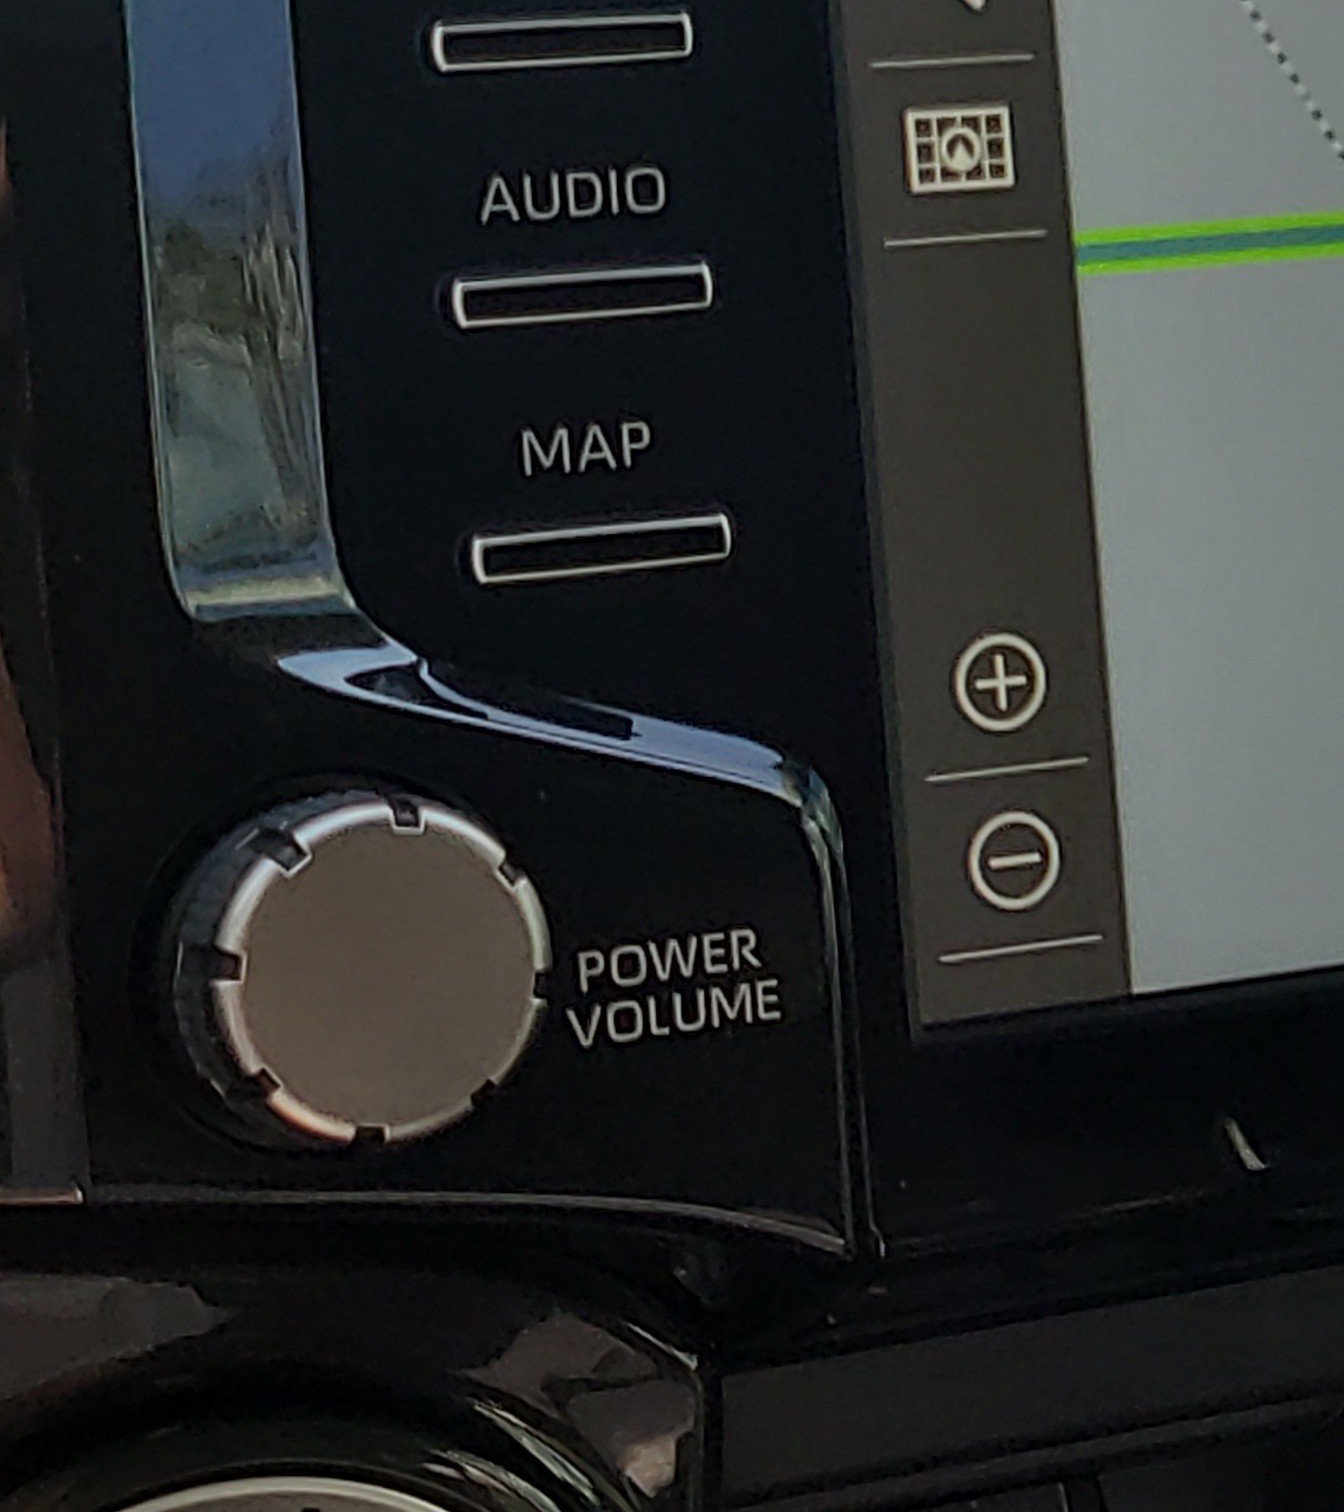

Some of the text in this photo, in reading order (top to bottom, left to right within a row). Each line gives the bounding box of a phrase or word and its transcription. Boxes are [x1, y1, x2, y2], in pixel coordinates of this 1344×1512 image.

[480, 166, 667, 225] AUDIO
[520, 420, 653, 477] MAP
[577, 928, 763, 994] POWER
[565, 978, 783, 1049] VOLUME
